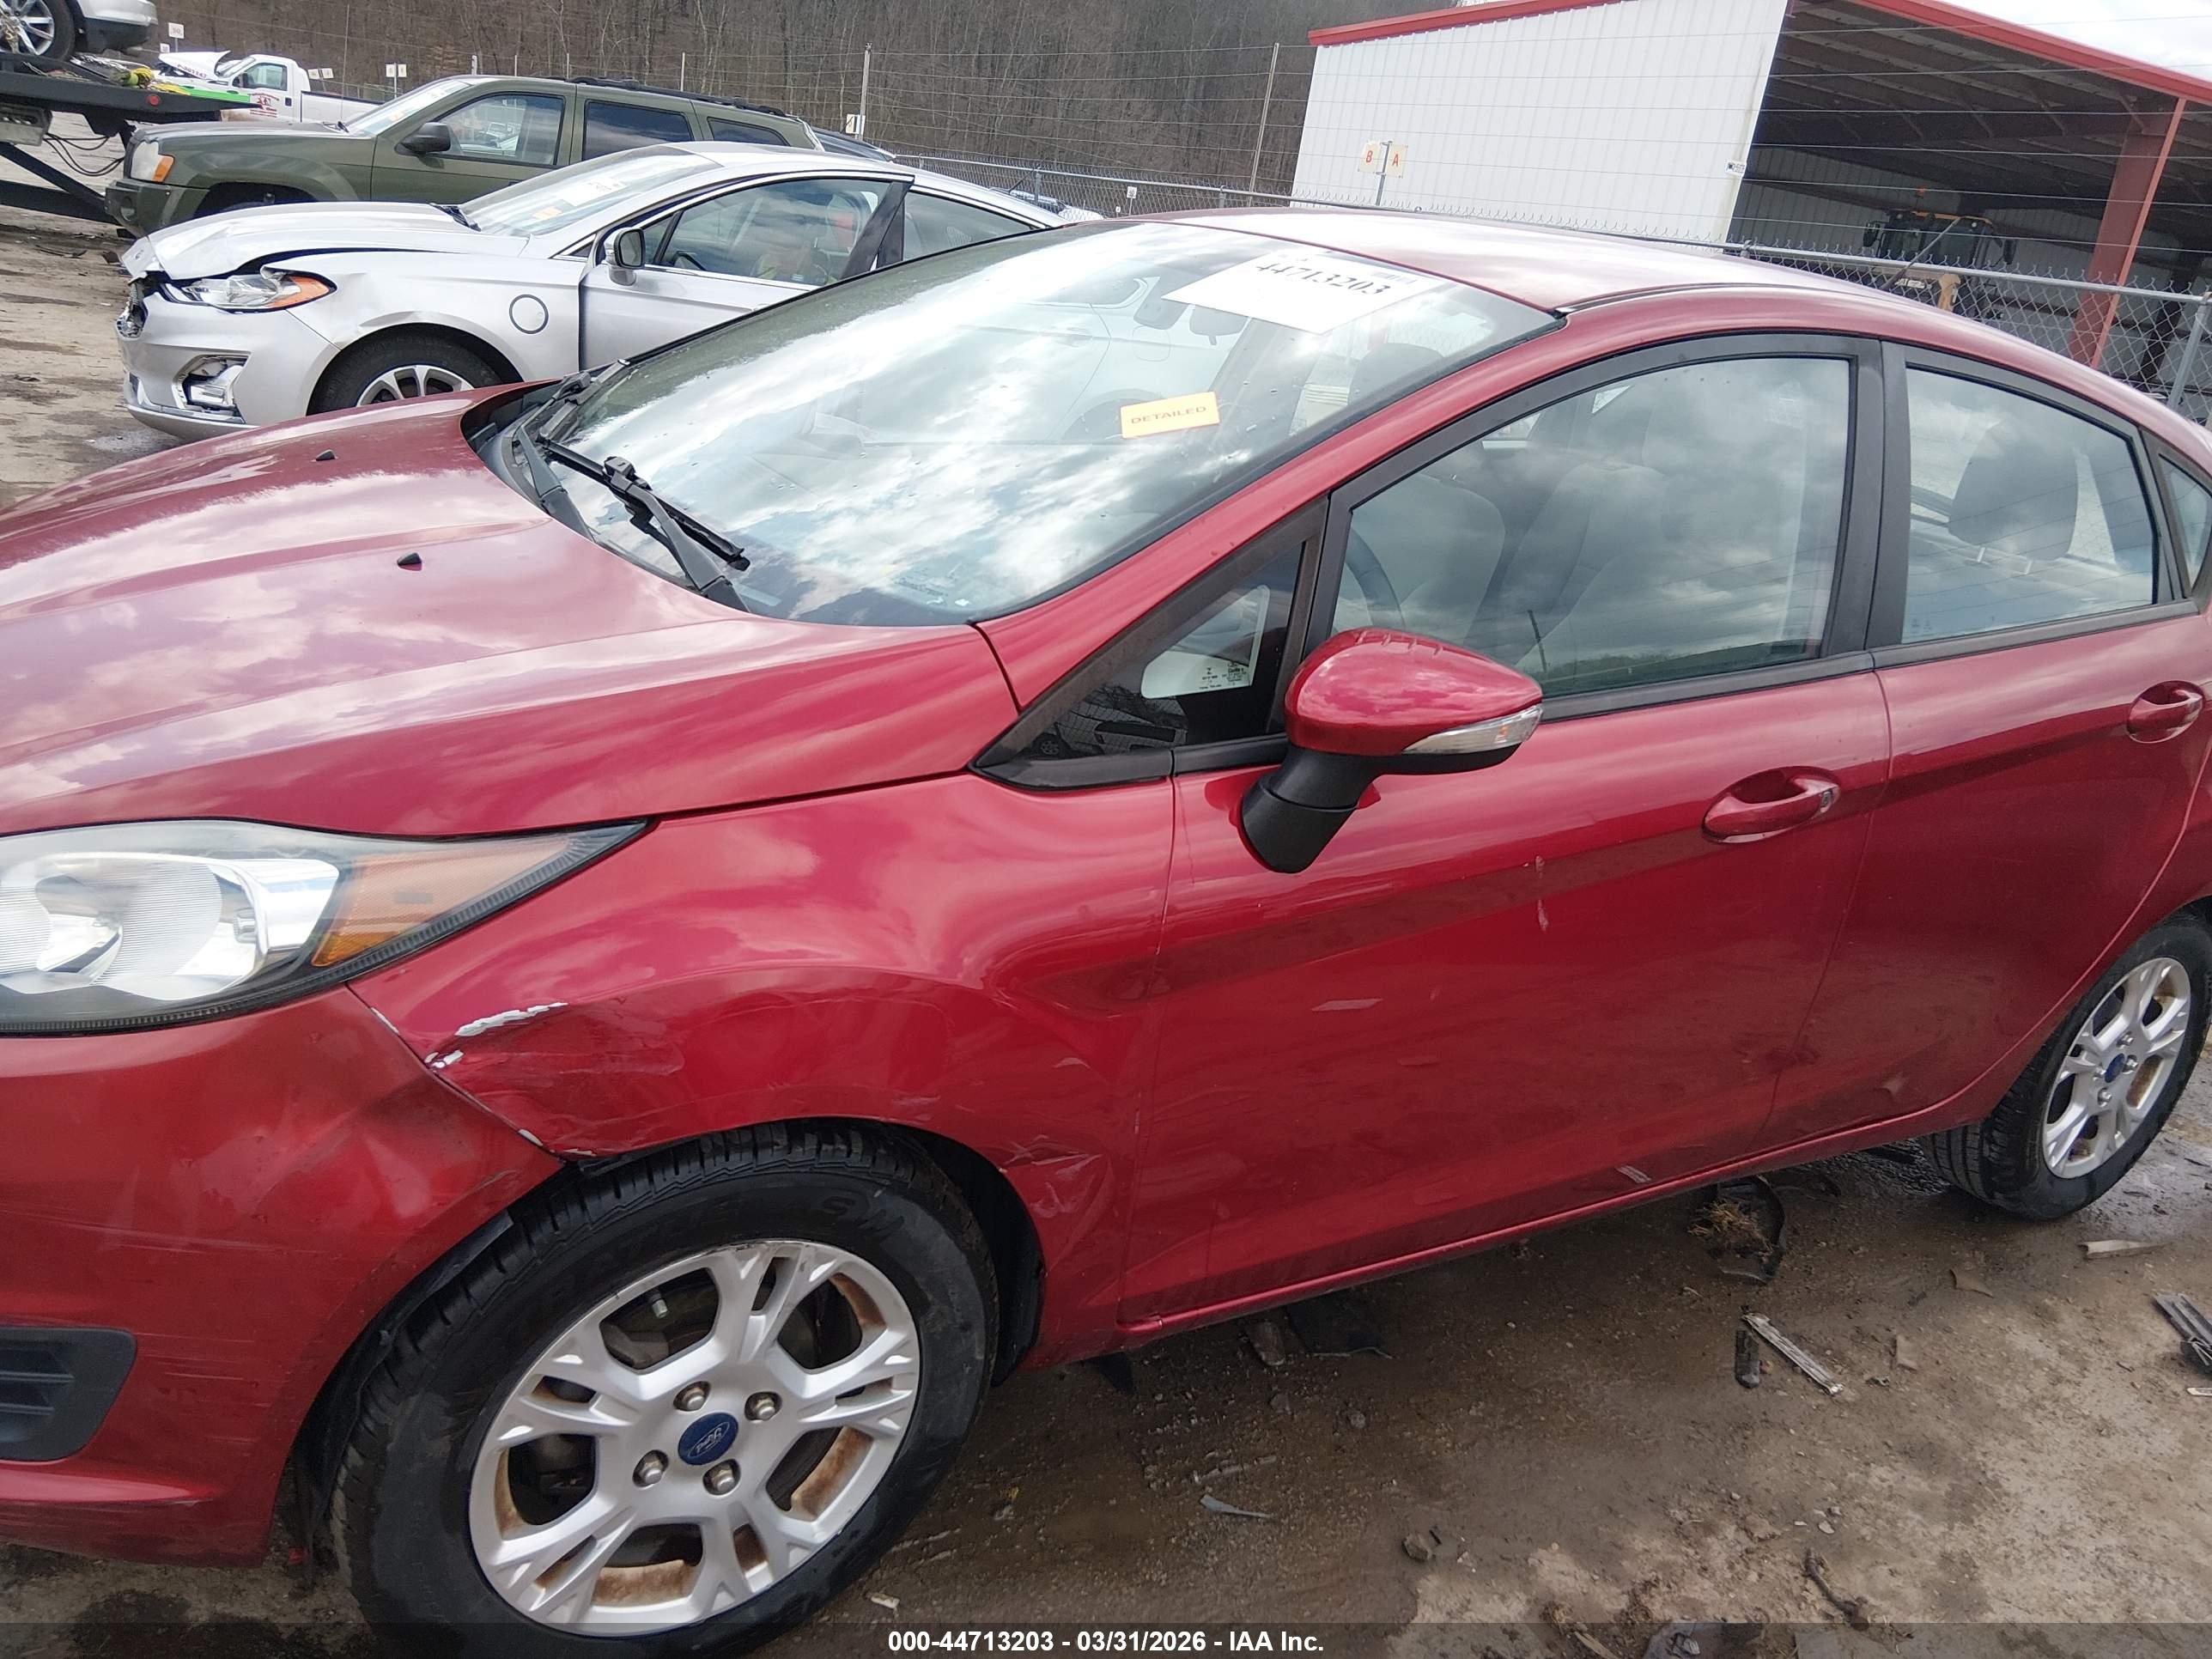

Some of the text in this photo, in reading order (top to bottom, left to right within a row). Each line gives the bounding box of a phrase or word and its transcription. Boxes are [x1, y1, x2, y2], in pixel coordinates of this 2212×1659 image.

[1365, 149, 1374, 163] B
[1391, 154, 1400, 167] A
[1255, 262, 1391, 295] 44713203
[1130, 406, 1207, 424] DETAILED
